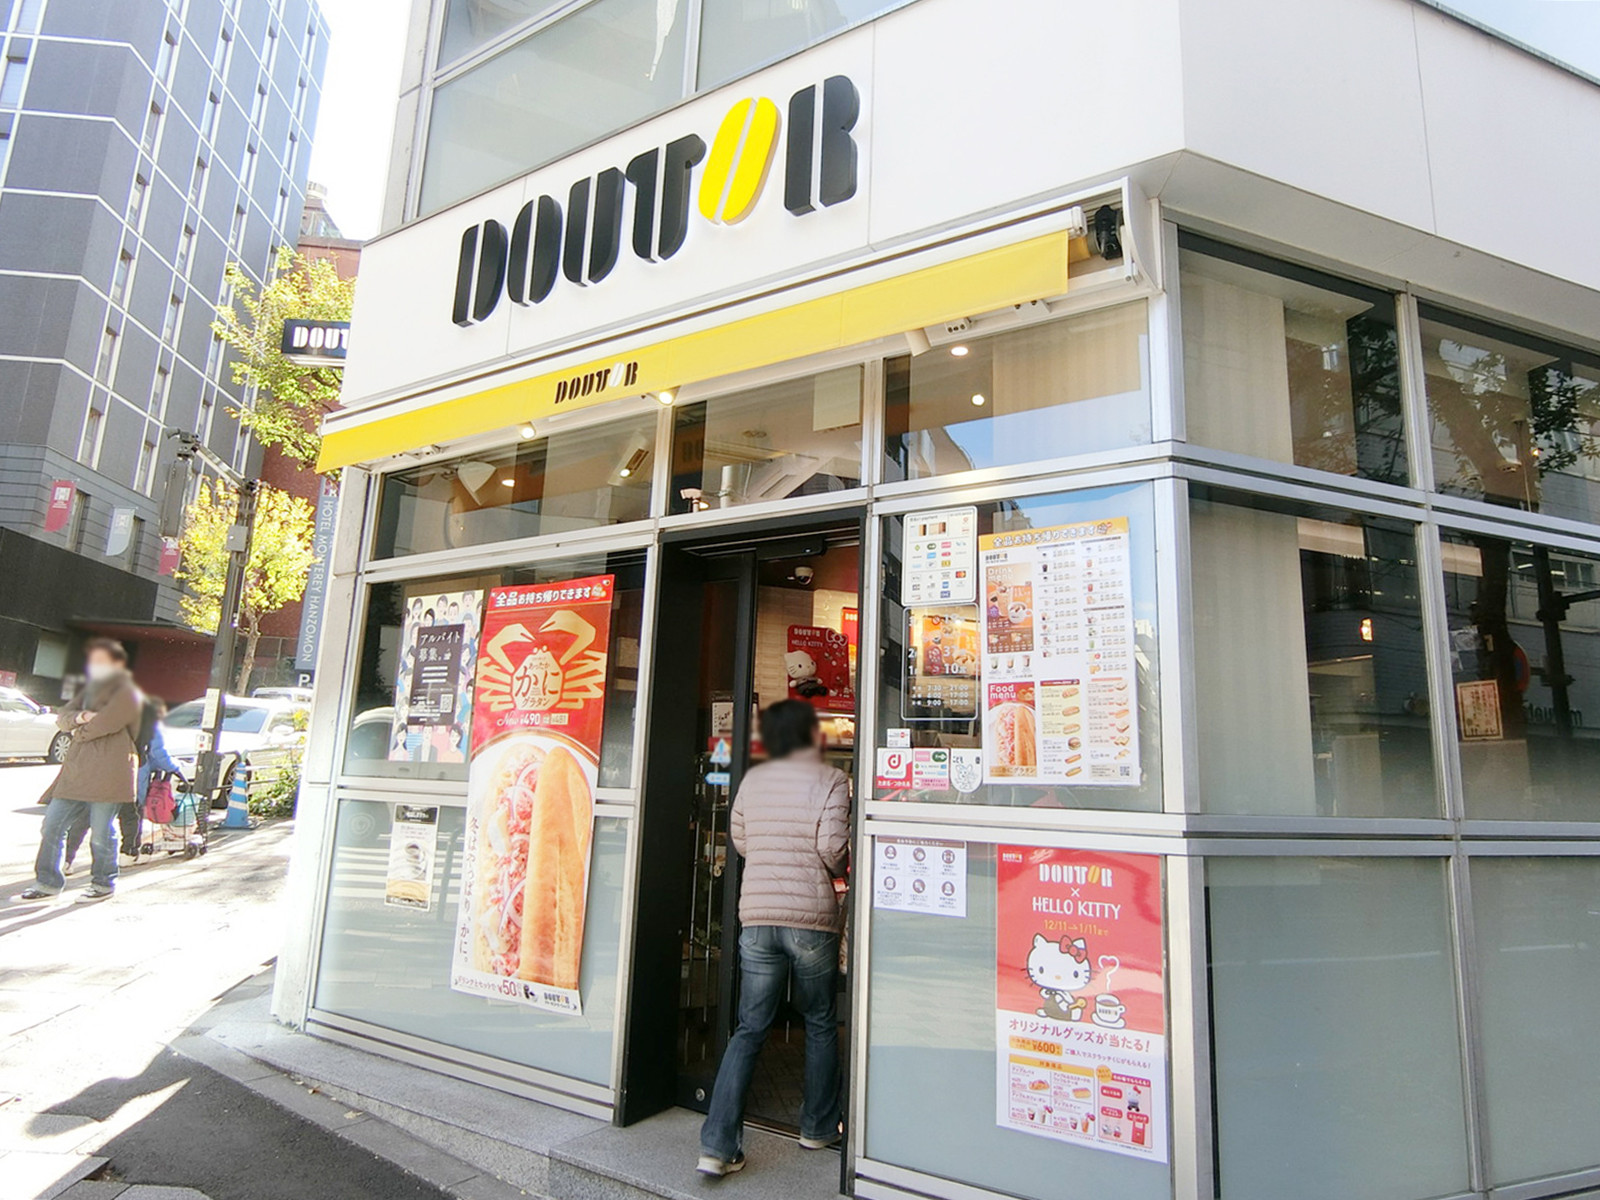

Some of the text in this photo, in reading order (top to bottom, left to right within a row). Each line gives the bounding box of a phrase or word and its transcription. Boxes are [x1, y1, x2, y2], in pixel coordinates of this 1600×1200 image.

[452, 74, 861, 327] DOUTOR
[554, 361, 639, 404] DOUTOR
[320, 500, 334, 535] HOTEL
[993, 525, 1096, 547] 全品お持ち帰りできます
[494, 586, 592, 608] 全品お持ち帰りできます
[301, 596, 321, 662] HANZOMON
[420, 631, 461, 646] アルバイト
[298, 674, 311, 687] P
[515, 665, 560, 698] かに
[990, 685, 1014, 693] Food
[521, 696, 551, 708] グラタン
[990, 691, 1016, 699] menu
[1039, 864, 1113, 888] DOUTOR
[458, 818, 480, 963] 冬はやっぱり、かに。
[1032, 896, 1122, 920] HELLO KITTY
